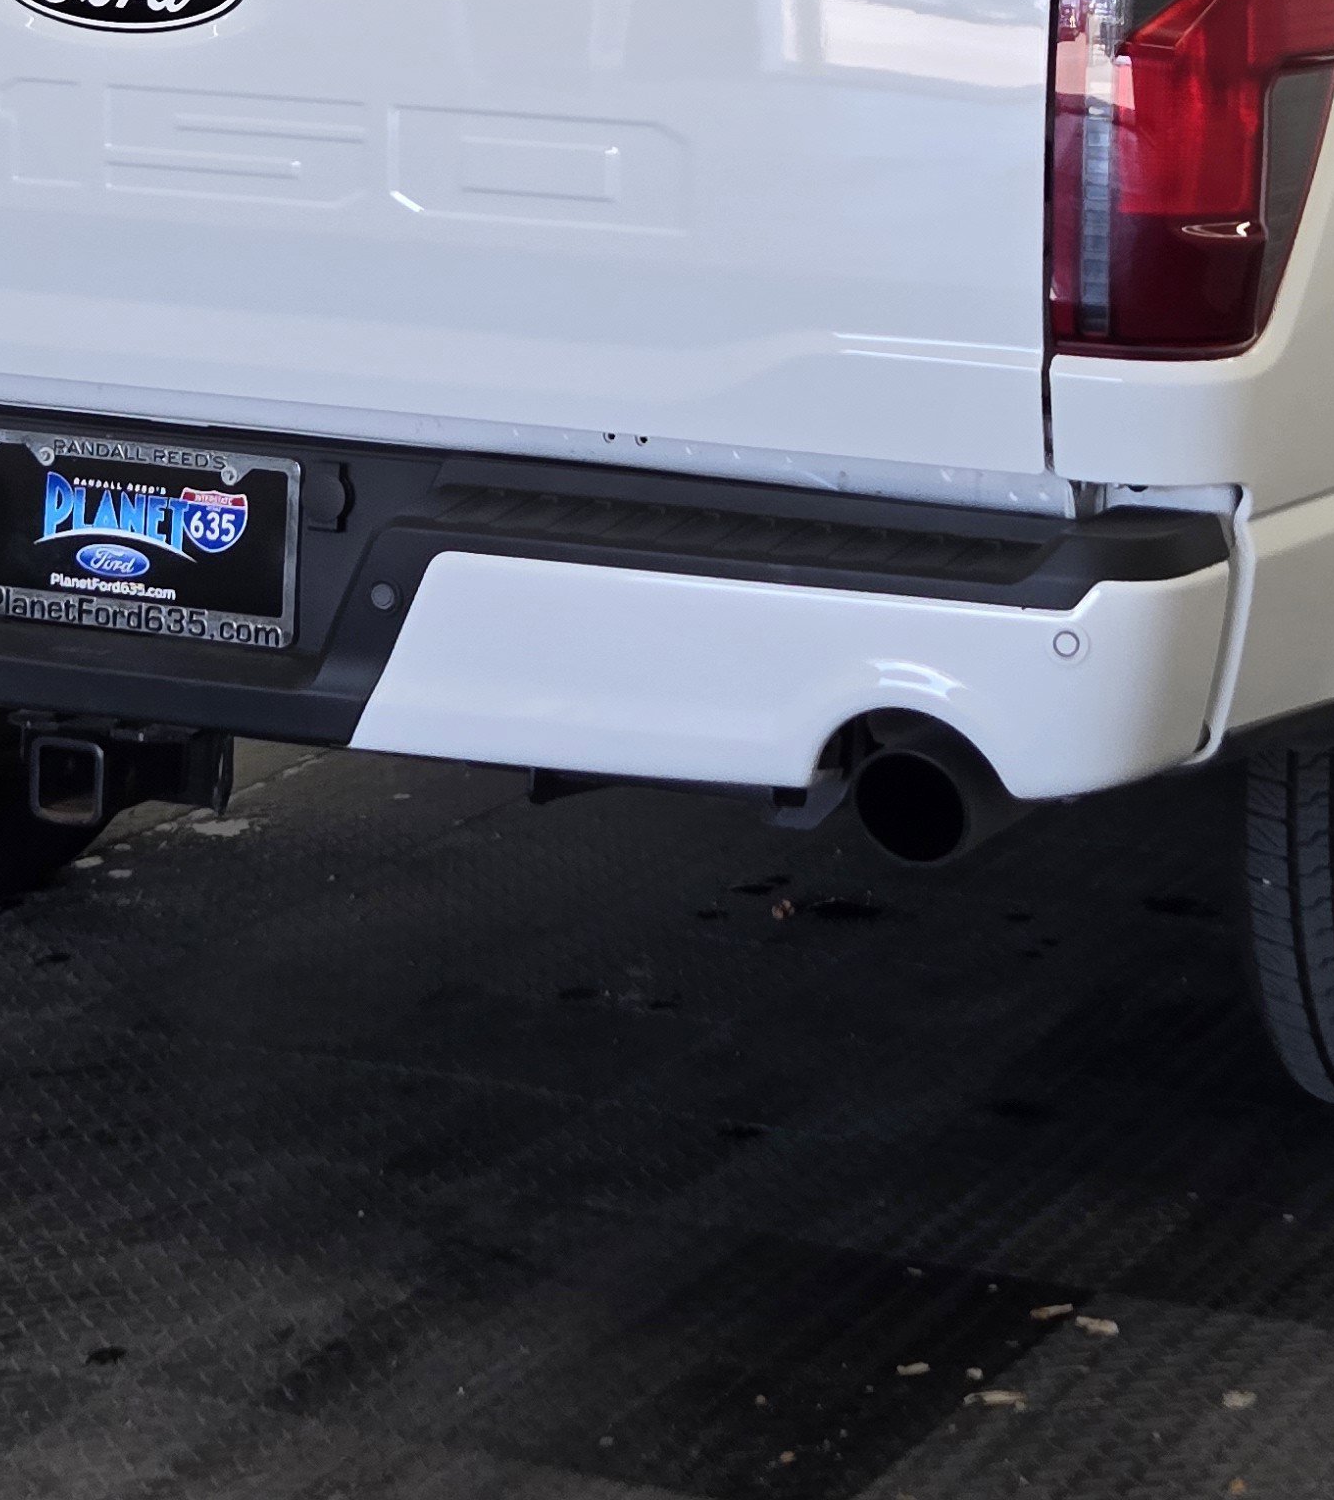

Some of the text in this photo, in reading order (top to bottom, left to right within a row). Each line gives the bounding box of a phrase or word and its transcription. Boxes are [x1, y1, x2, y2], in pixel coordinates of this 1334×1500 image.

[53, 439, 227, 470] RANDALL REED'S
[44, 471, 191, 552] PLANET
[190, 510, 236, 543] 635
[90, 549, 137, 573] Ford
[50, 573, 176, 601] PlanetFord635.com
